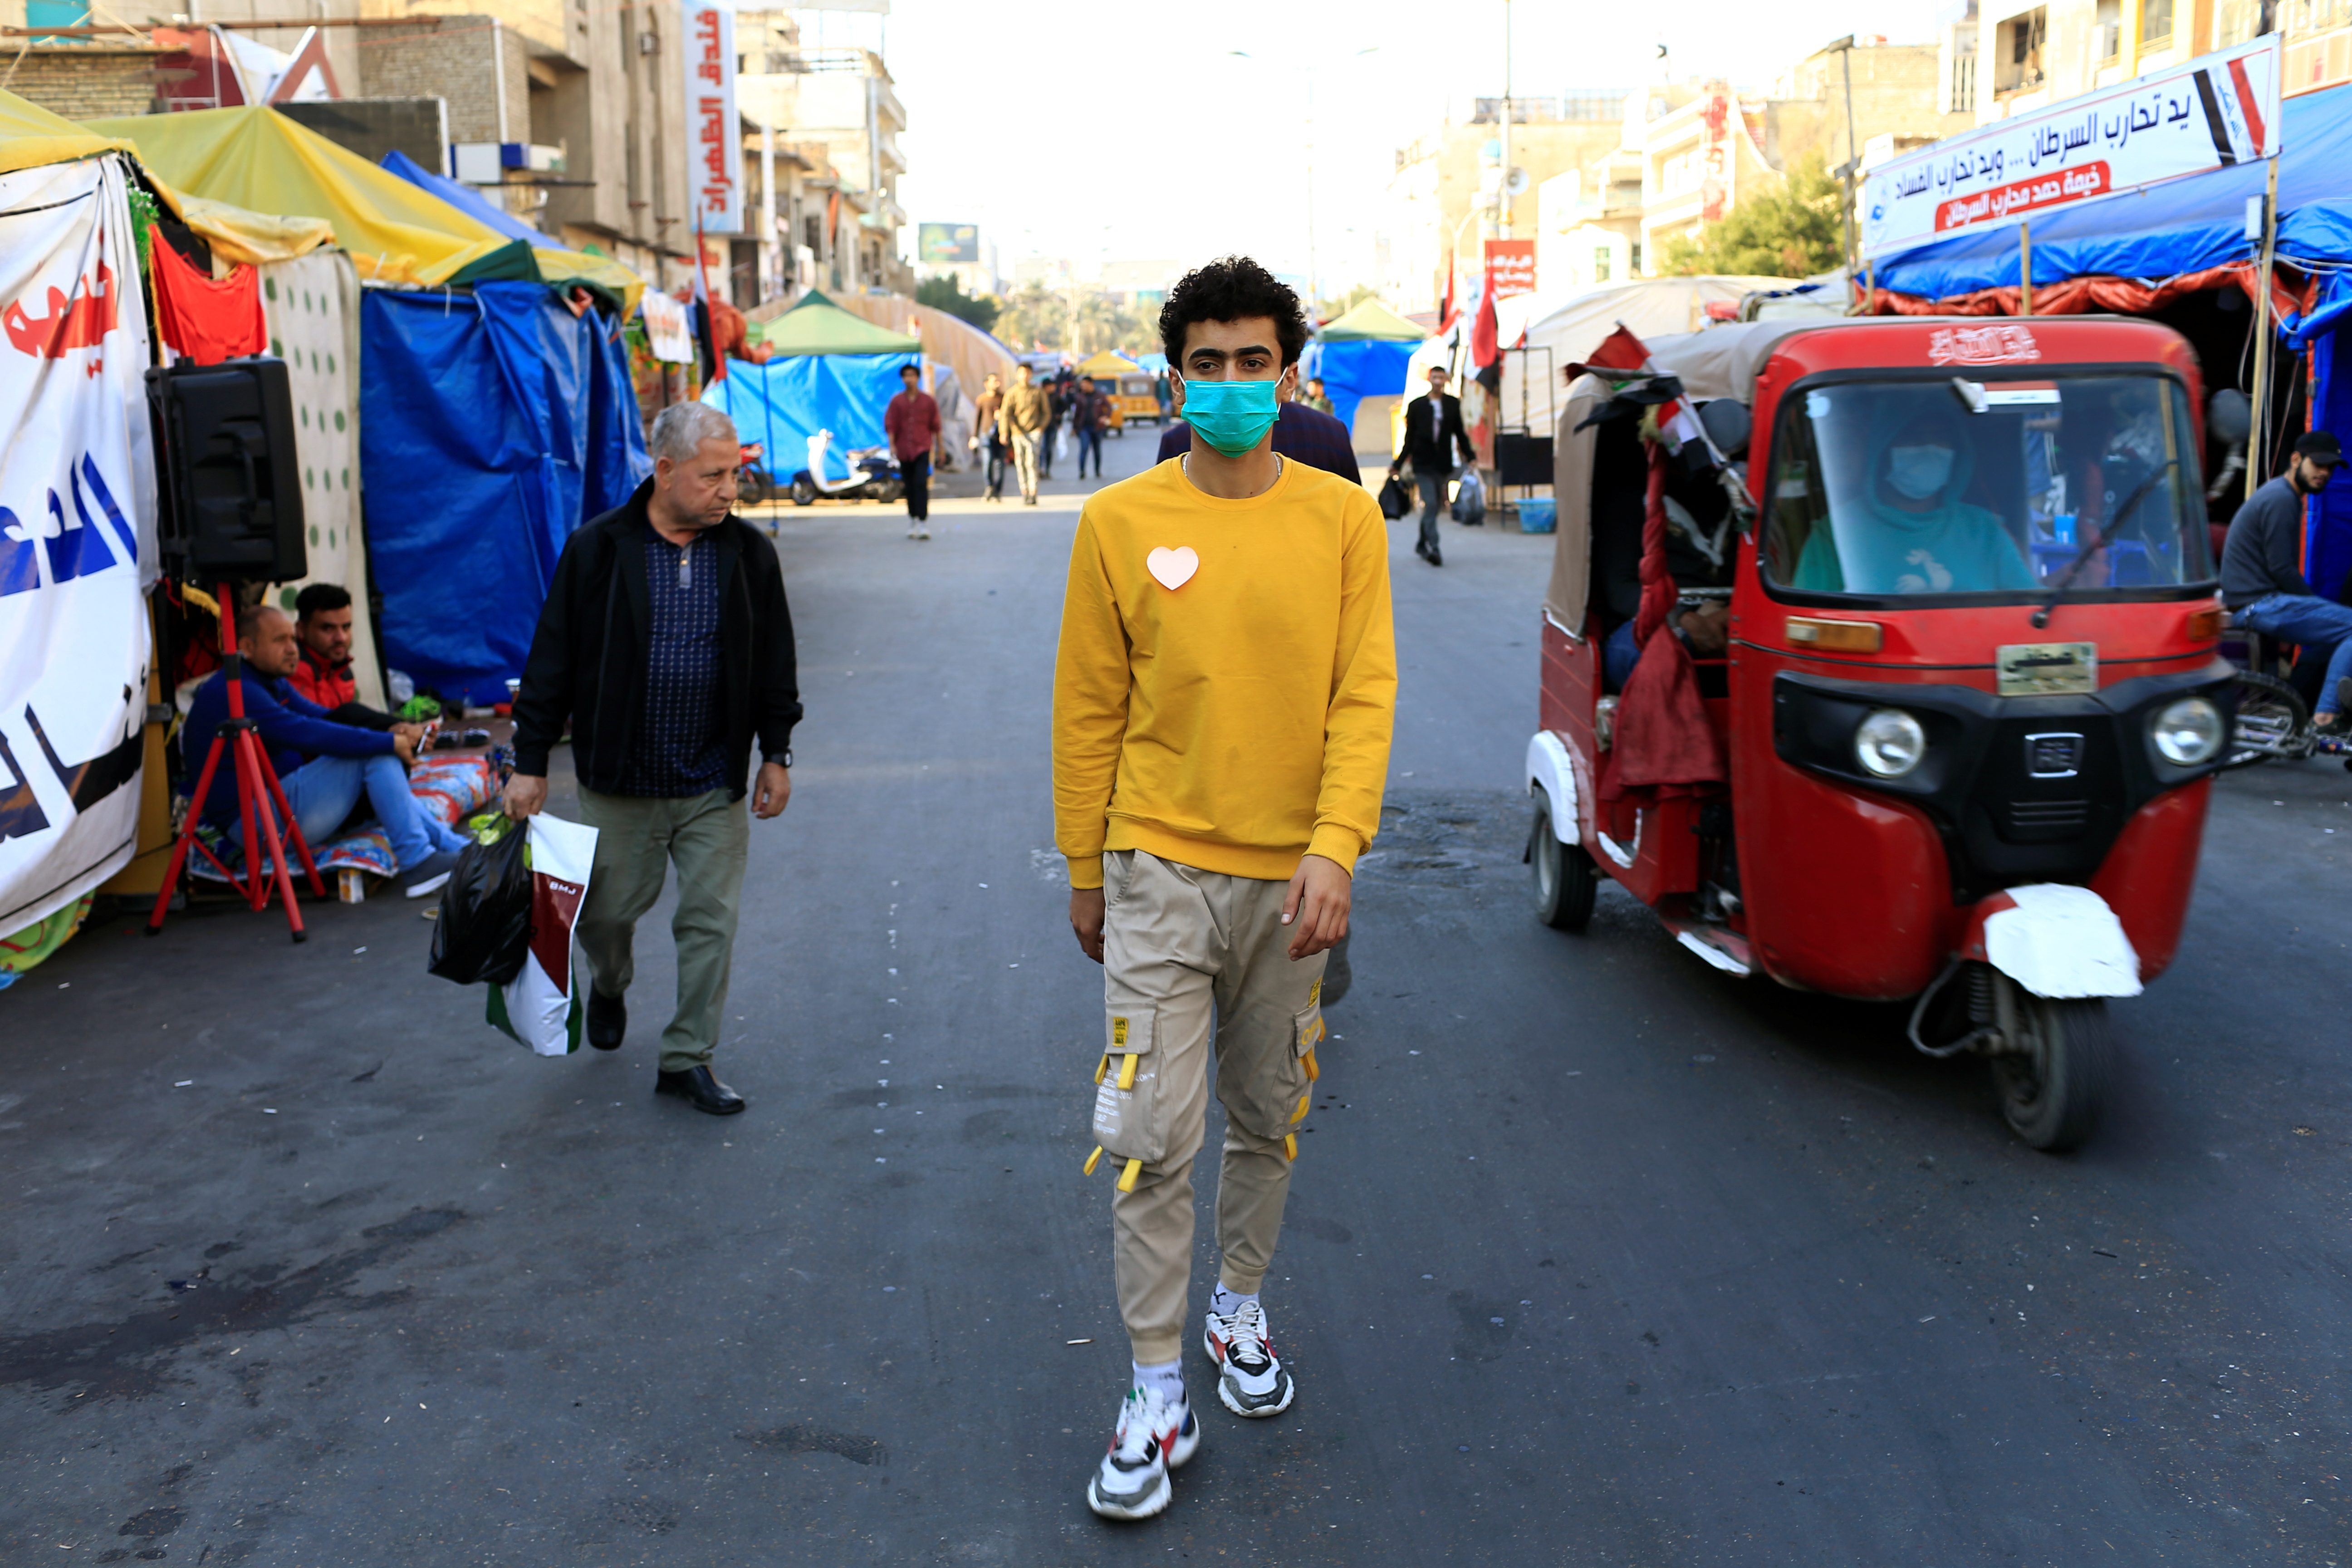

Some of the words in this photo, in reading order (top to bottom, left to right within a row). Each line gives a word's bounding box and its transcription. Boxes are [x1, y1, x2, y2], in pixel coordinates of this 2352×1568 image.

[696, 9, 722, 86] فندق
[2105, 93, 2161, 149] تحارب
[2167, 94, 2191, 130] يد
[2029, 112, 2097, 167] السرطان
[1896, 164, 1933, 200] الفساد
[1979, 149, 2004, 181] ويد
[2063, 164, 2102, 196] خيمة
[1990, 186, 2031, 216] محارب
[2031, 180, 2062, 203] حمد
[1945, 192, 1990, 227] السرطان
